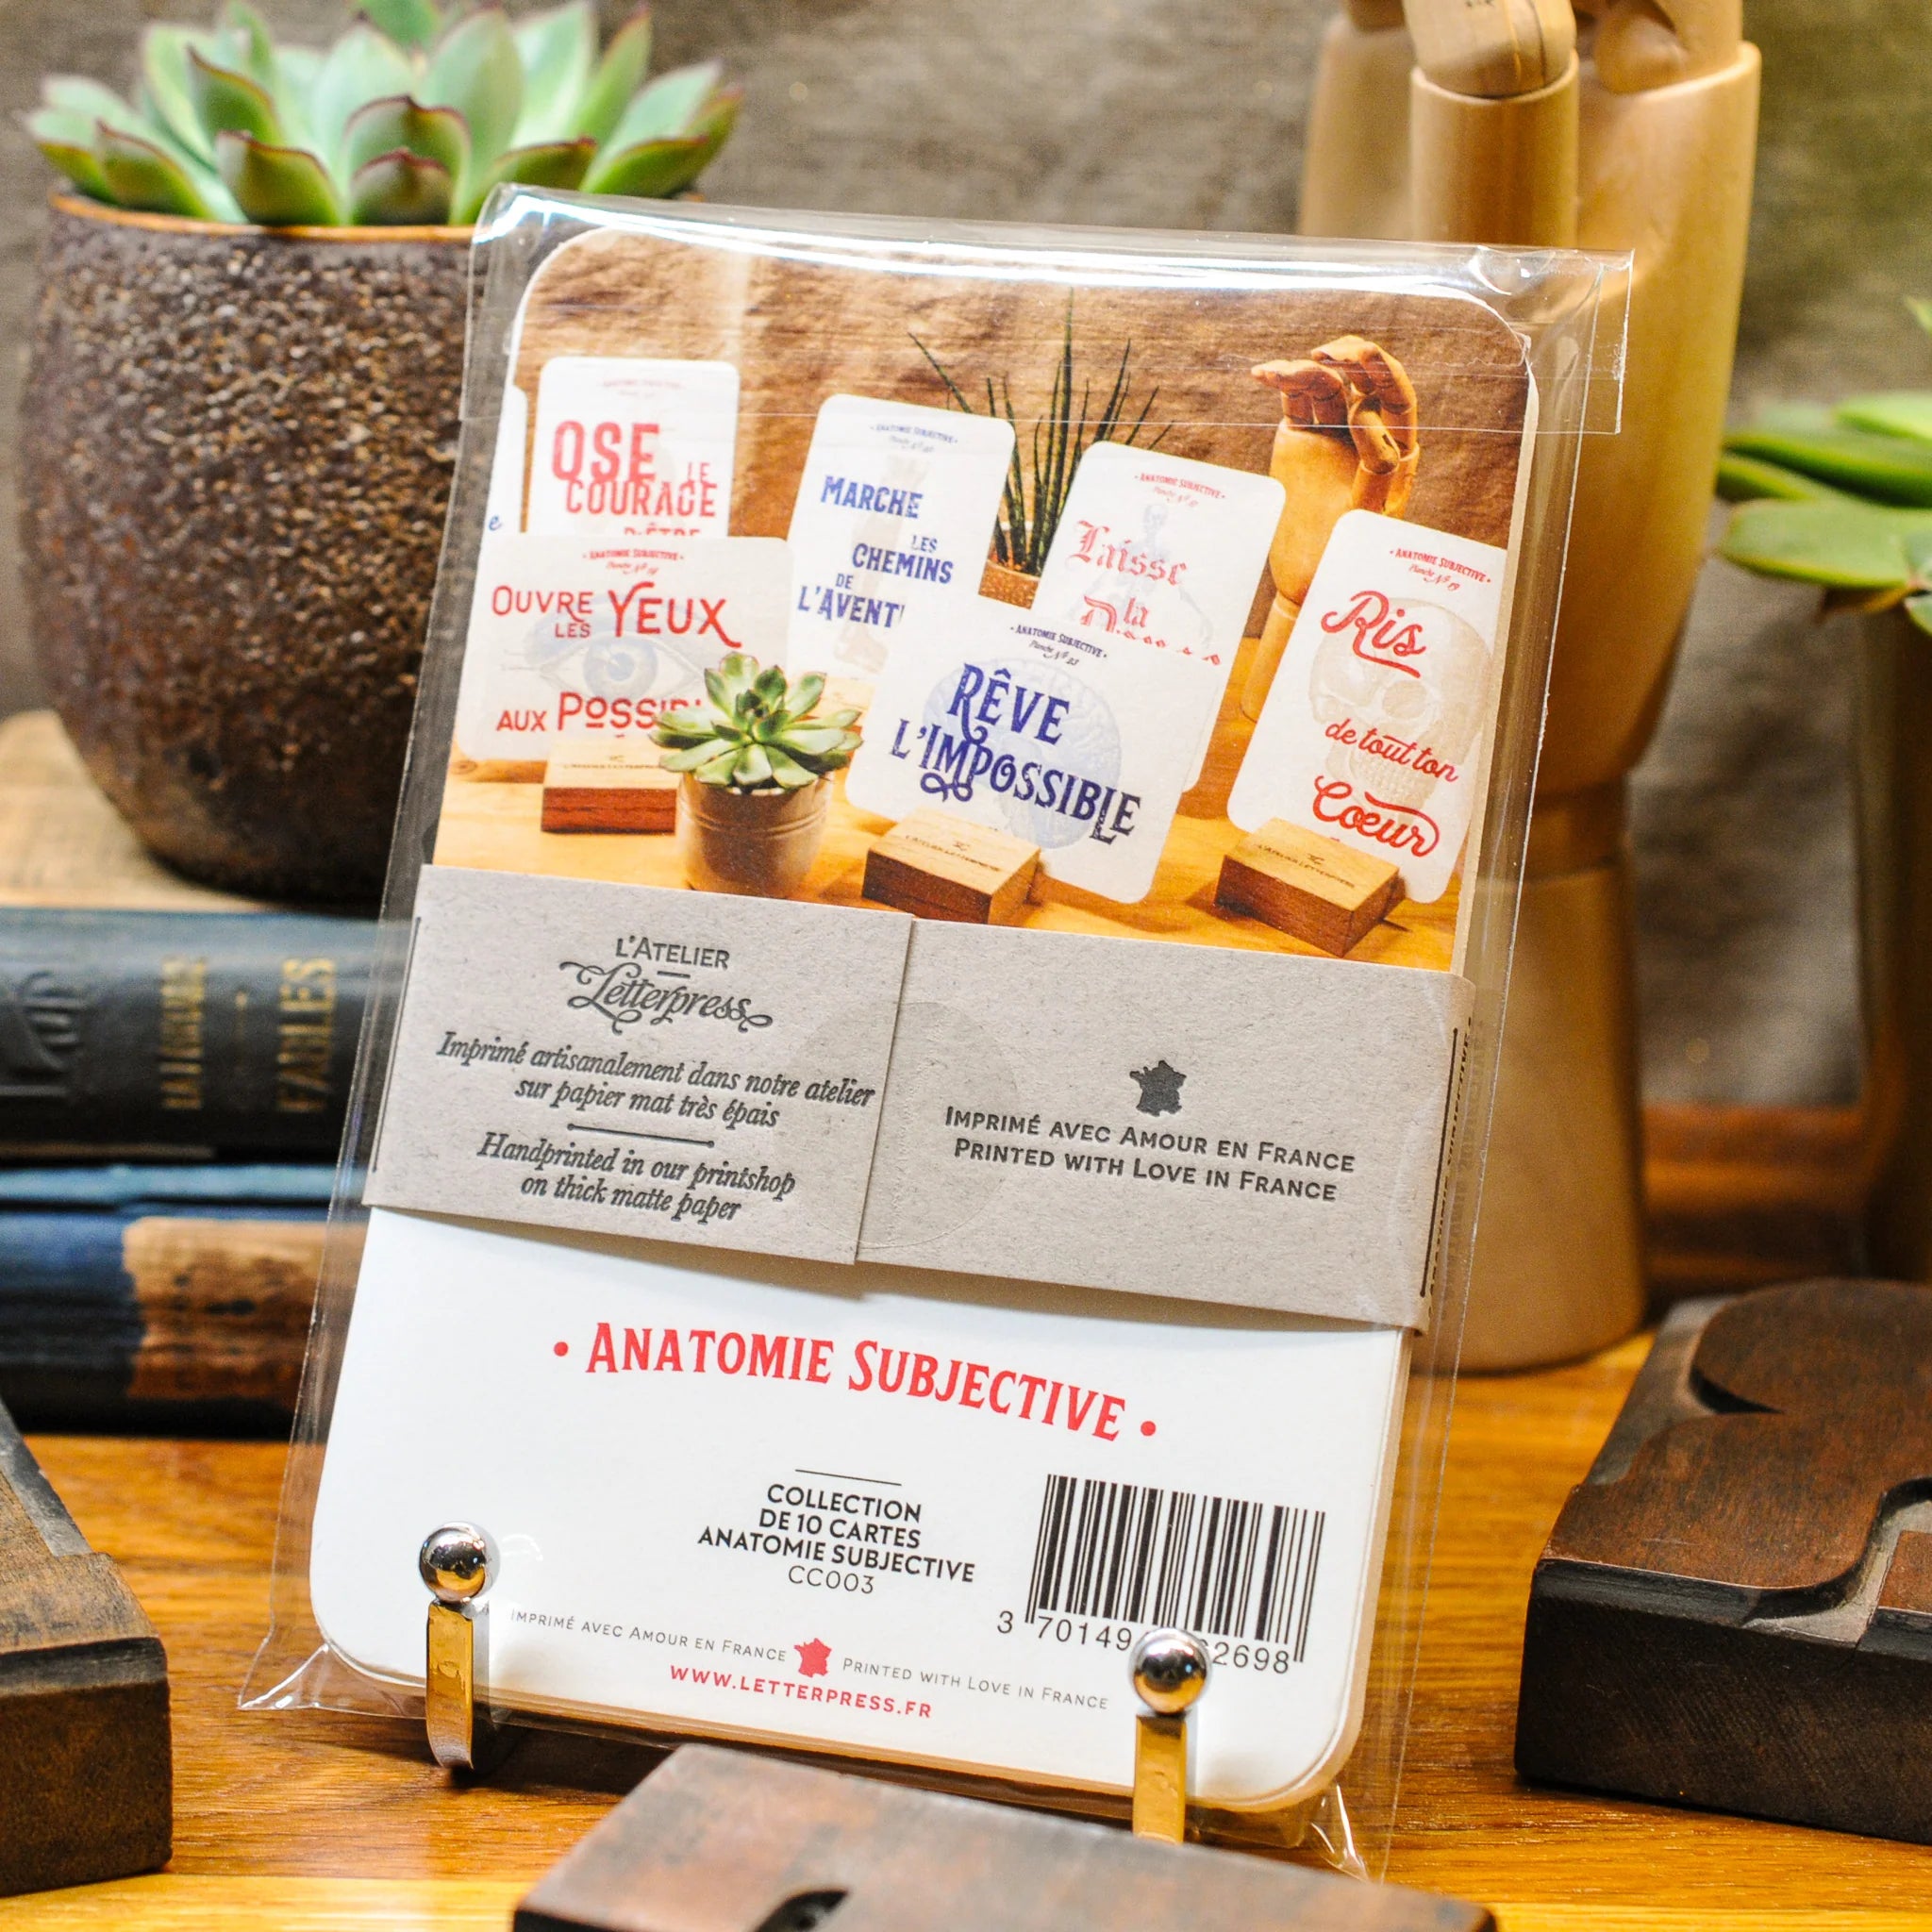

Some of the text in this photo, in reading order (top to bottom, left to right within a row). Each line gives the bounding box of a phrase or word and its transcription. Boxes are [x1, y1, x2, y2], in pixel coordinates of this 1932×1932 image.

[552, 419, 659, 482] OSE
[566, 478, 718, 517] COURAGE
[820, 475, 923, 519] MARCHE
[852, 542, 954, 585] CHEMINS
[910, 534, 938, 555] LES
[1395, 547, 1487, 583] ANATOMIE SUBJECTIVE
[491, 585, 593, 623] OUVRE
[835, 573, 854, 590] DE
[555, 581, 742, 649] LES YEUX
[1016, 624, 1057, 641] ANATOMIE
[1058, 633, 1104, 658] SUBJECTIVE
[1320, 590, 1427, 678] Ris
[496, 708, 547, 732] AUX
[946, 662, 1070, 745] RÊVE
[1324, 718, 1460, 783] de tout ton
[889, 718, 1141, 845] L'IMPOSSIBLE
[615, 934, 730, 970] L'ATELIER
[558, 960, 774, 1034] Letterpress
[436, 1031, 875, 1108] Imprimé artisanalement dans notre atelier
[514, 1077, 780, 1130] sur papier mat très épais
[945, 1105, 1356, 1174] IMPRIMÉ AVEC AMOUR EN FRANCE
[476, 1131, 795, 1202] Handprinted in our printshop
[953, 1137, 1339, 1201] PRINTED WITH LOVE IN FRANCE
[520, 1174, 741, 1224] on thick matte paper
[586, 1322, 1126, 1441] ANATOMIE SUBJECTIVE
[758, 1507, 922, 1550] DE 10 CARTES
[767, 1483, 923, 1524] COLLECTION
[697, 1525, 975, 1583] ANATOMIE SUBJECTIVE
[788, 1564, 874, 1594] CC003
[510, 1607, 787, 1662] IMPRIMÉ AVEC AMOUR EN FRANCE
[997, 1610, 1291, 1674] 3 70149 2698
[670, 1664, 932, 1718] WWW.LETTERPRESS.FR
[842, 1657, 1109, 1710] PRINTED WITH LOVE IN FRANCE
